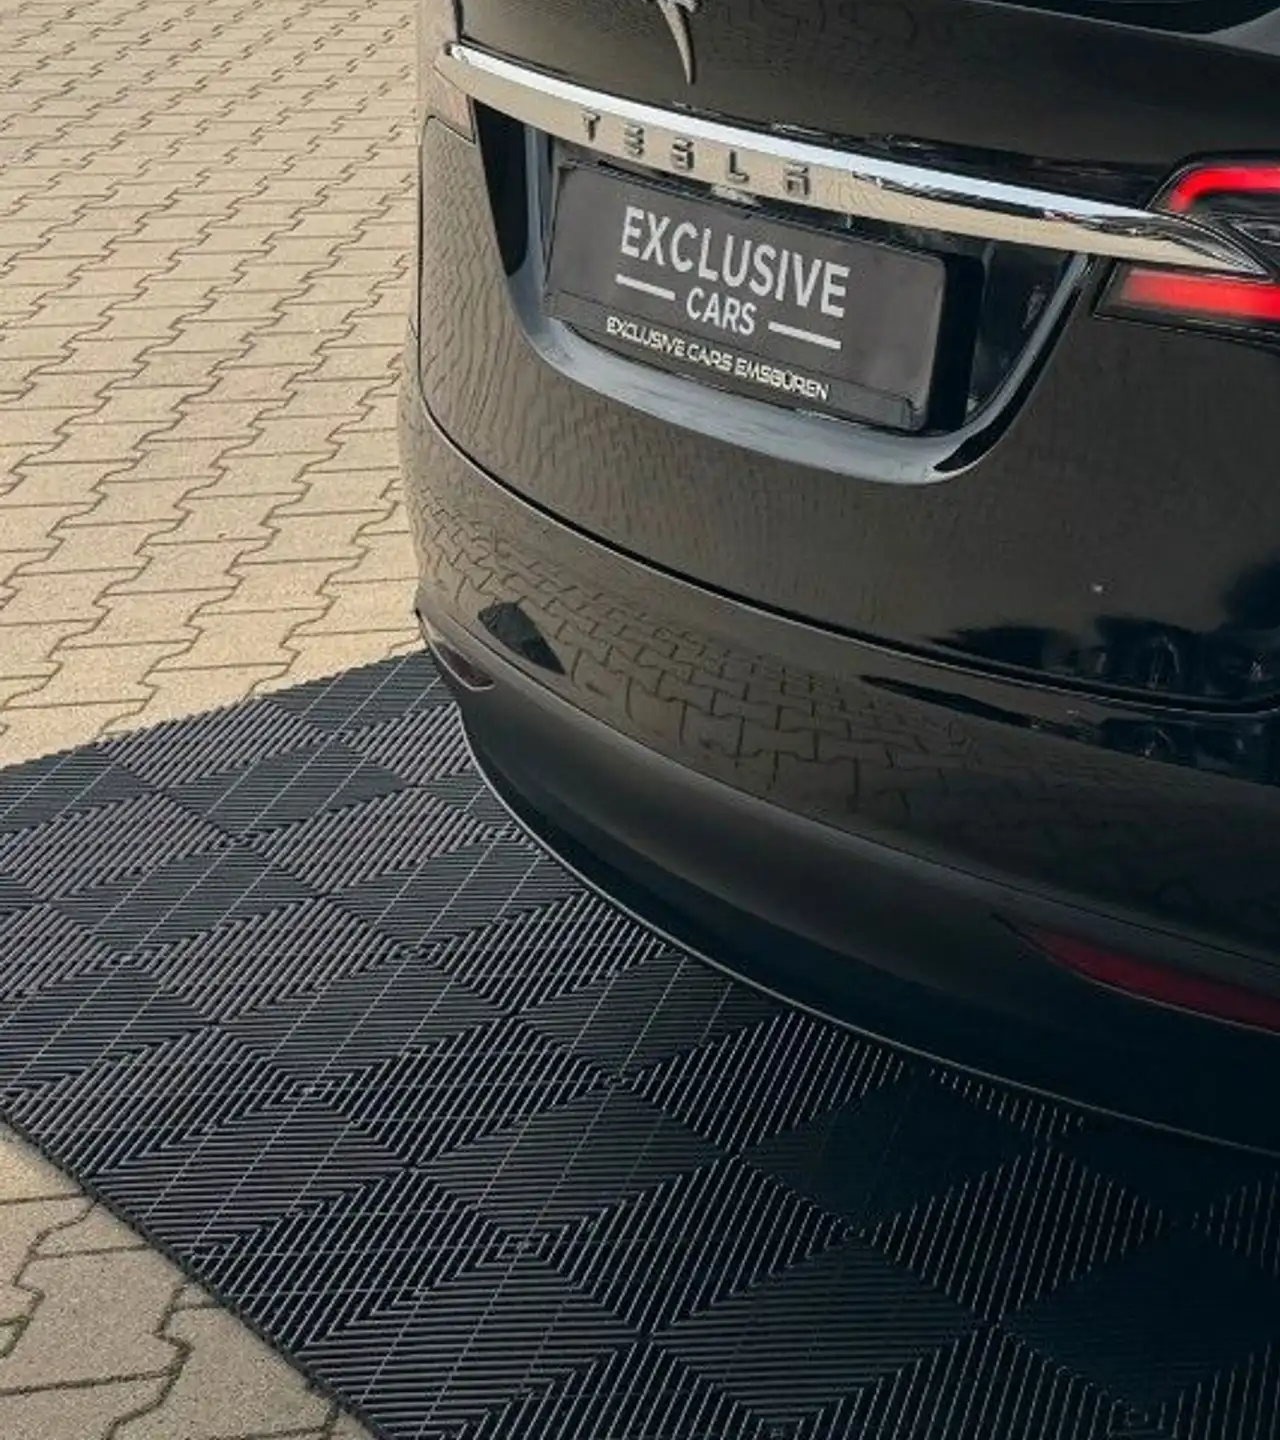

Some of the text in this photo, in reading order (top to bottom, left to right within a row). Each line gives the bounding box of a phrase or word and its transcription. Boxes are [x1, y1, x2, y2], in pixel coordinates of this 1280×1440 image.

[582, 111, 810, 195] TESLA
[621, 206, 850, 318] EXCLUSIVE
[686, 286, 757, 336] CARS
[606, 315, 829, 401] EXCLUSIVE CARS EMSBÜREN
